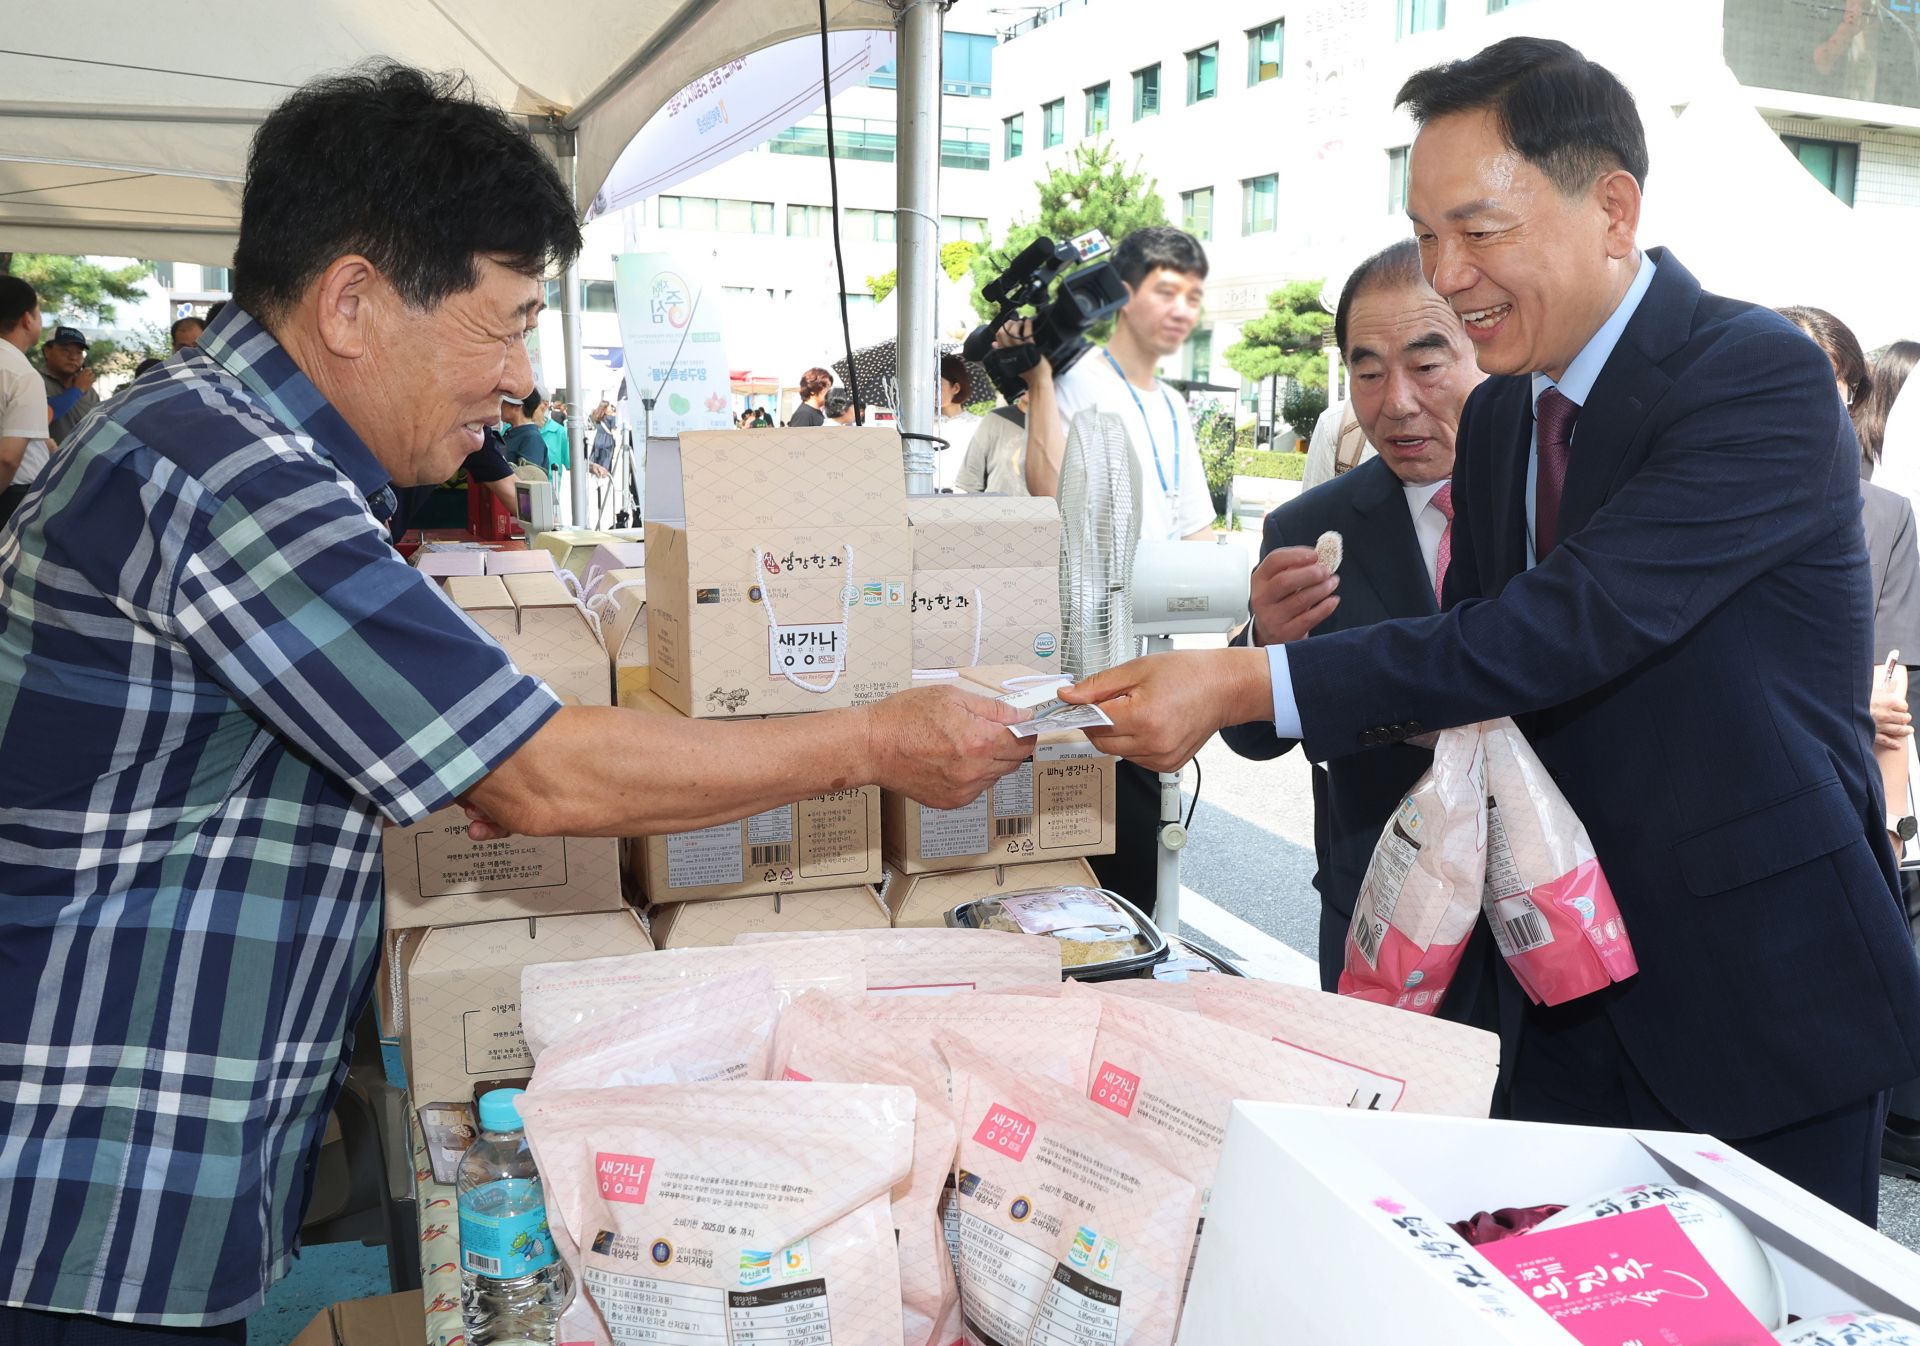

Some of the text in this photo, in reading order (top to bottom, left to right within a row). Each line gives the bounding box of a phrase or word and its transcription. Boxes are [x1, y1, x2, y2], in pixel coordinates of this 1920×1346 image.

[781, 551, 843, 571] 생강한과
[779, 630, 838, 667] 생강나
[853, 682, 899, 692] 생강나찹쌀유과
[1047, 768, 1064, 777] Why
[491, 1004, 516, 1014] 이렇게
[1099, 1070, 1136, 1103] 생강나
[986, 1112, 1031, 1148] 생강나
[599, 1160, 646, 1195] 생강나
[1039, 1183, 1062, 1197] 소비기한
[975, 1191, 1001, 1210] 대상수상
[673, 1217, 699, 1230] 소비기한
[740, 1227, 755, 1239] 까지
[1030, 1216, 1061, 1238] 소비자대상
[611, 1248, 640, 1262] 대상수상
[676, 1246, 691, 1256] 2014
[676, 1255, 714, 1270] 소비자대상
[740, 1266, 770, 1280] 서산뜨레
[613, 1276, 631, 1286] 생강나
[632, 1279, 658, 1290] 찹쌀유과
[732, 1296, 759, 1306] 영양정보
[784, 1302, 814, 1313] 126.15Kcal
[625, 1314, 645, 1325] 서산시
[692, 1323, 700, 1332] 71
[785, 1312, 824, 1325] 5.85mg(0.3%)
[625, 1327, 658, 1340] 표기일까지
[786, 1323, 827, 1337] 23.16g(7.14%)
